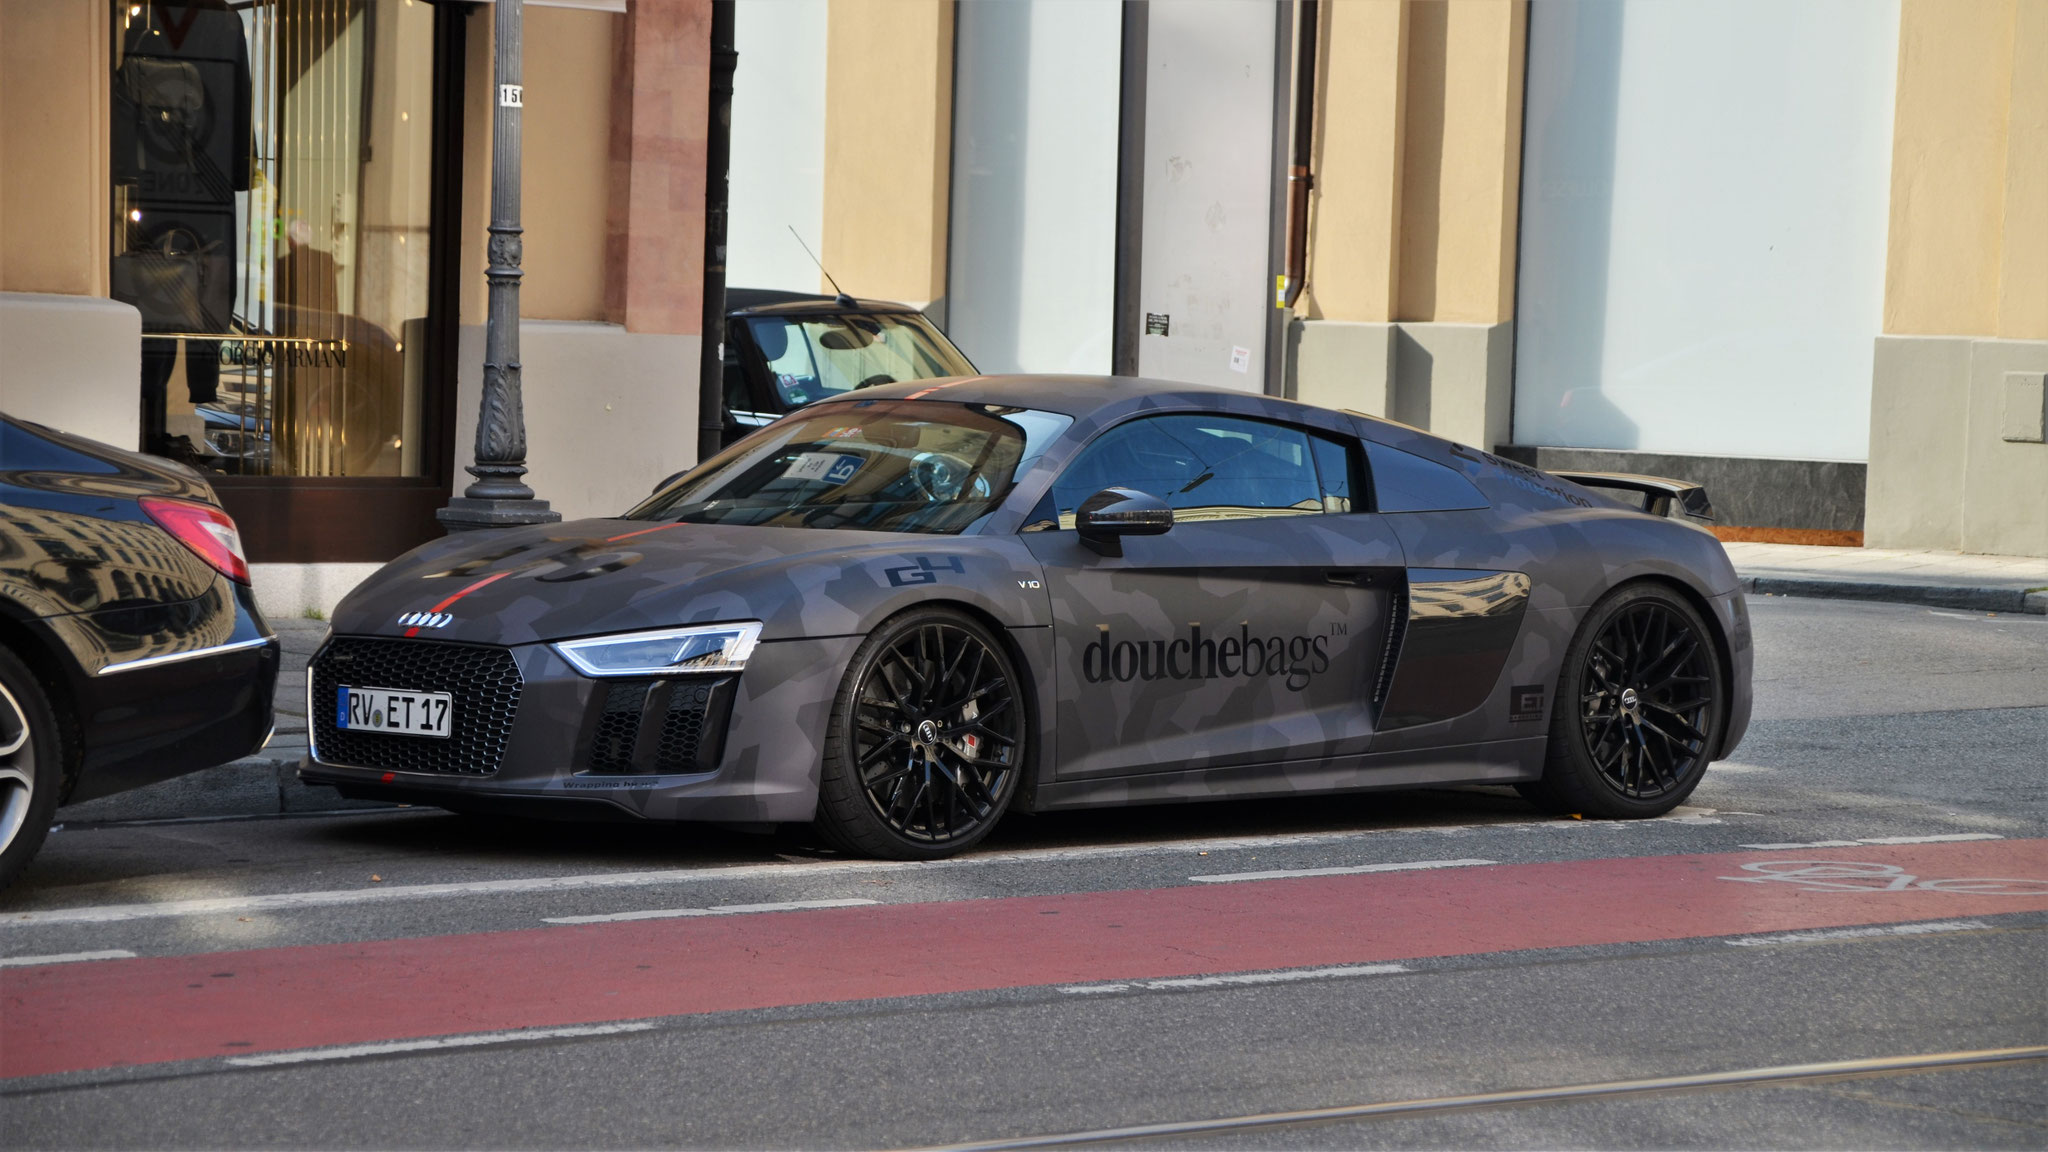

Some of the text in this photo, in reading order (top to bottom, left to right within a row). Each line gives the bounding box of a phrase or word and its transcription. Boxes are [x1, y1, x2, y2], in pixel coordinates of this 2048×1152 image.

[283, 348, 347, 368] ARMANI
[1082, 620, 1329, 692] douchebags
[348, 693, 448, 731] RV ET 17
